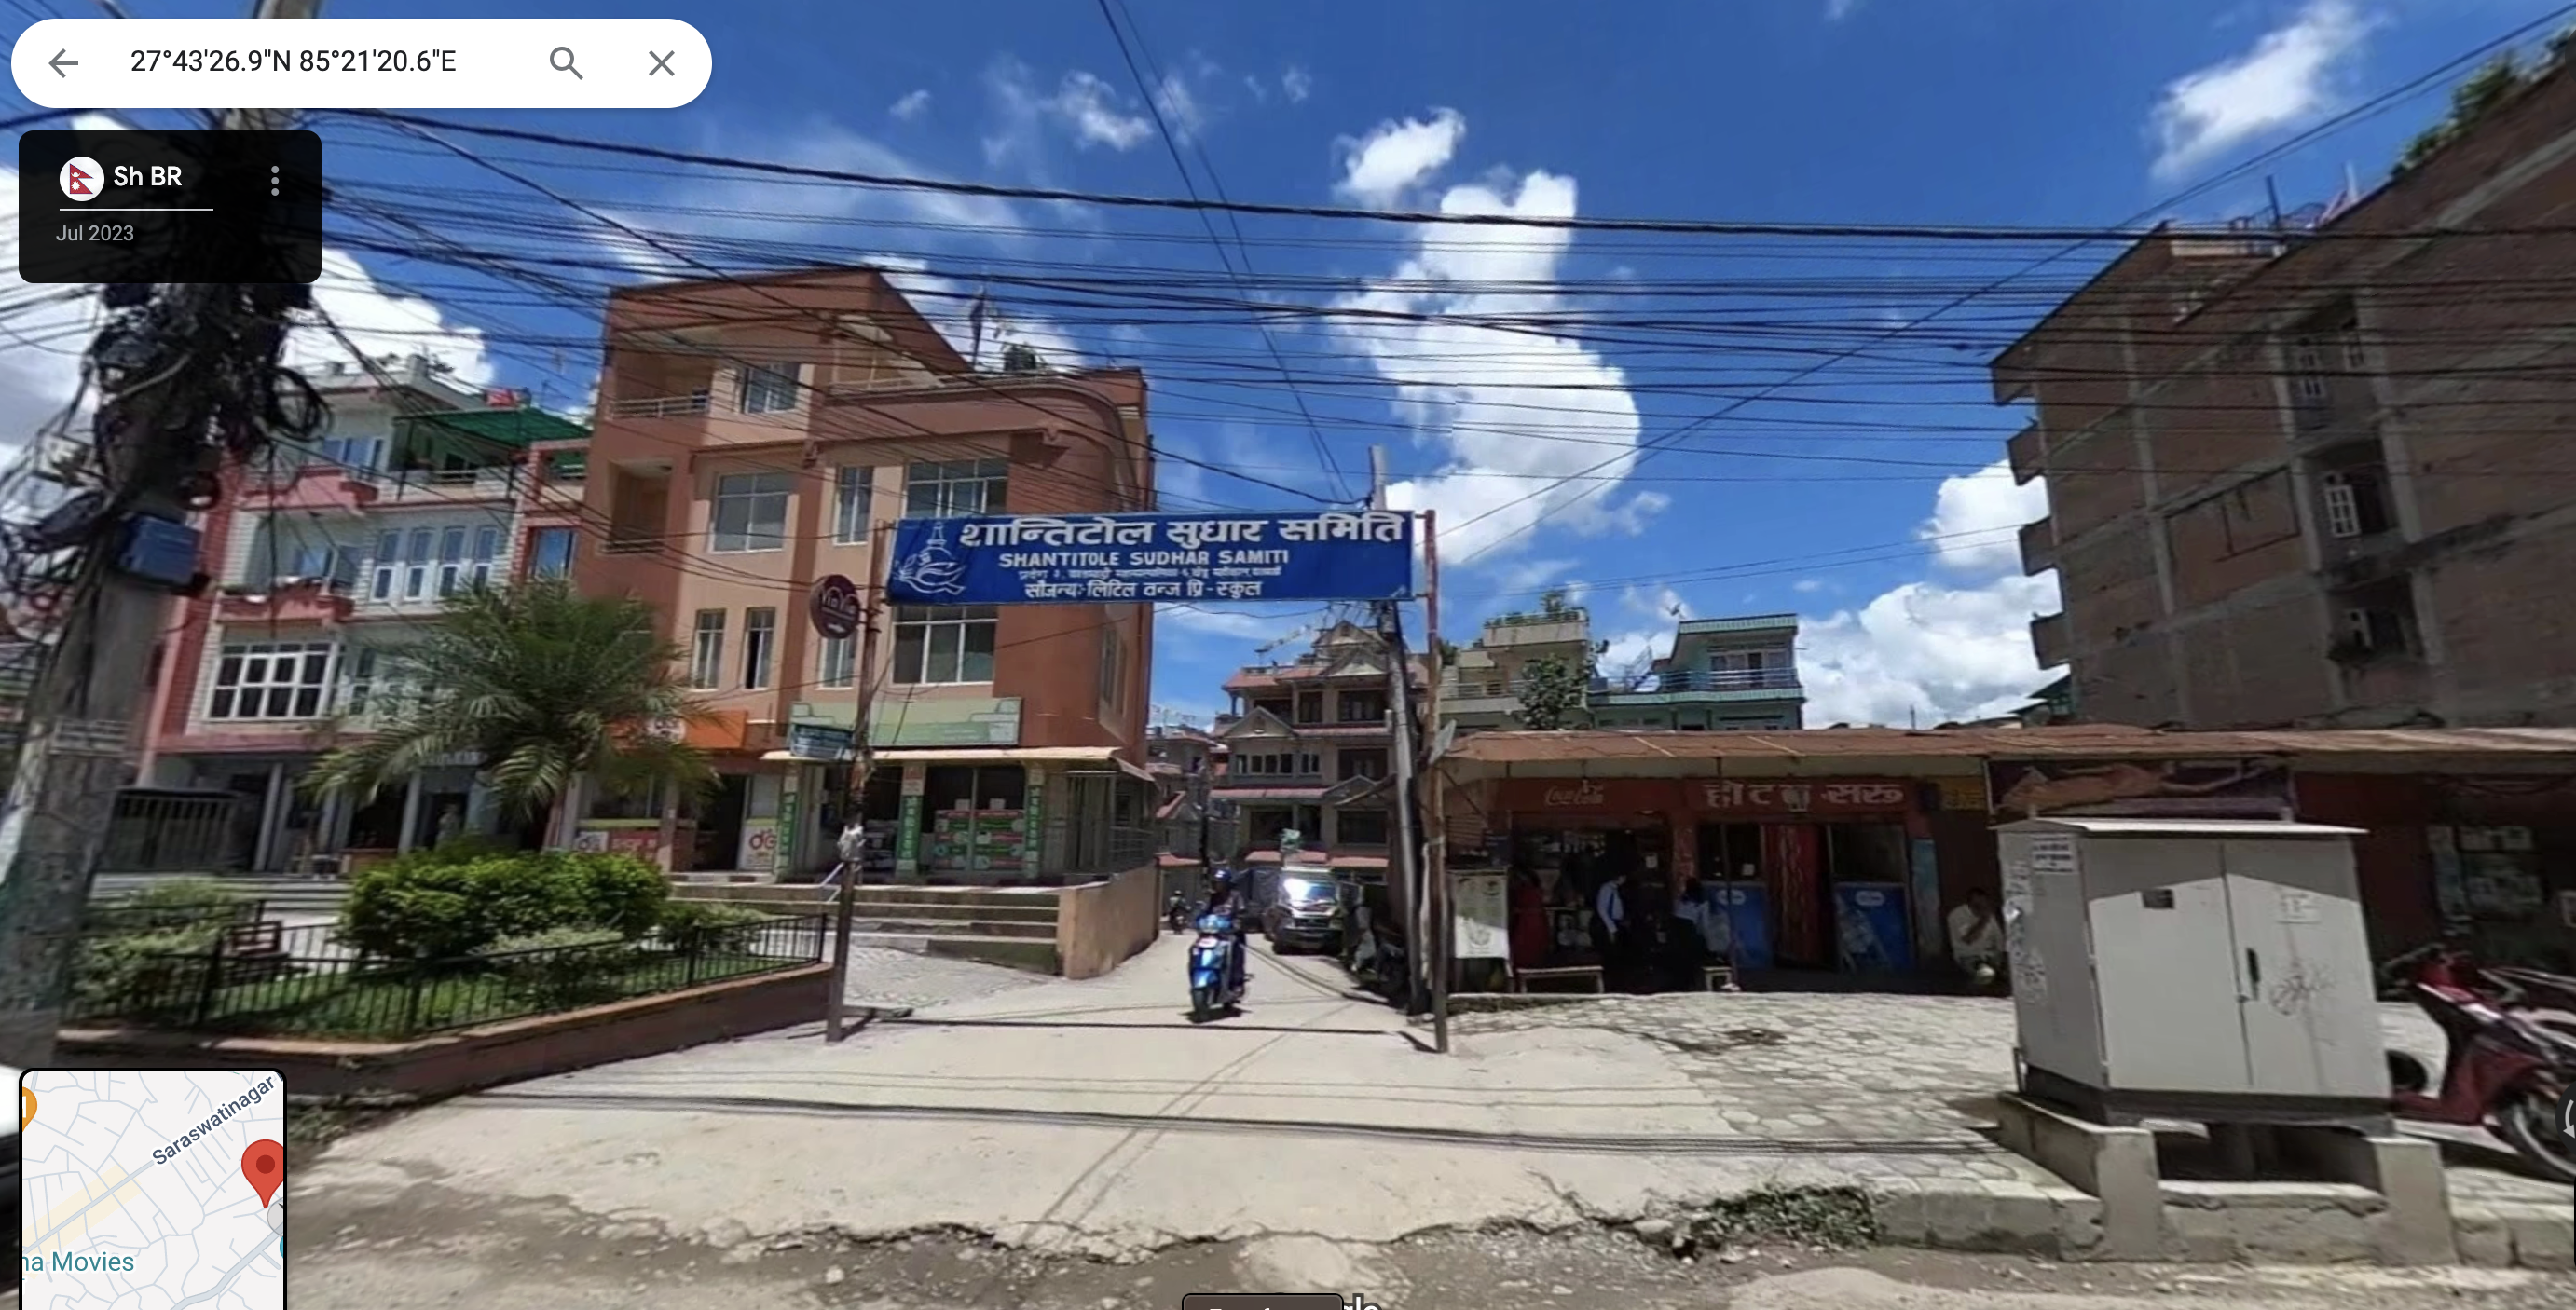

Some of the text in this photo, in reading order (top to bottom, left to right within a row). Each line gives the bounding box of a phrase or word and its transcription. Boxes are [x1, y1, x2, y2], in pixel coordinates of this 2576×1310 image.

[1166, 519, 1268, 549] सुधार
[1278, 512, 1404, 542] समिति
[998, 548, 1289, 568] SHANTITOLE SUDHAR SAMITI
